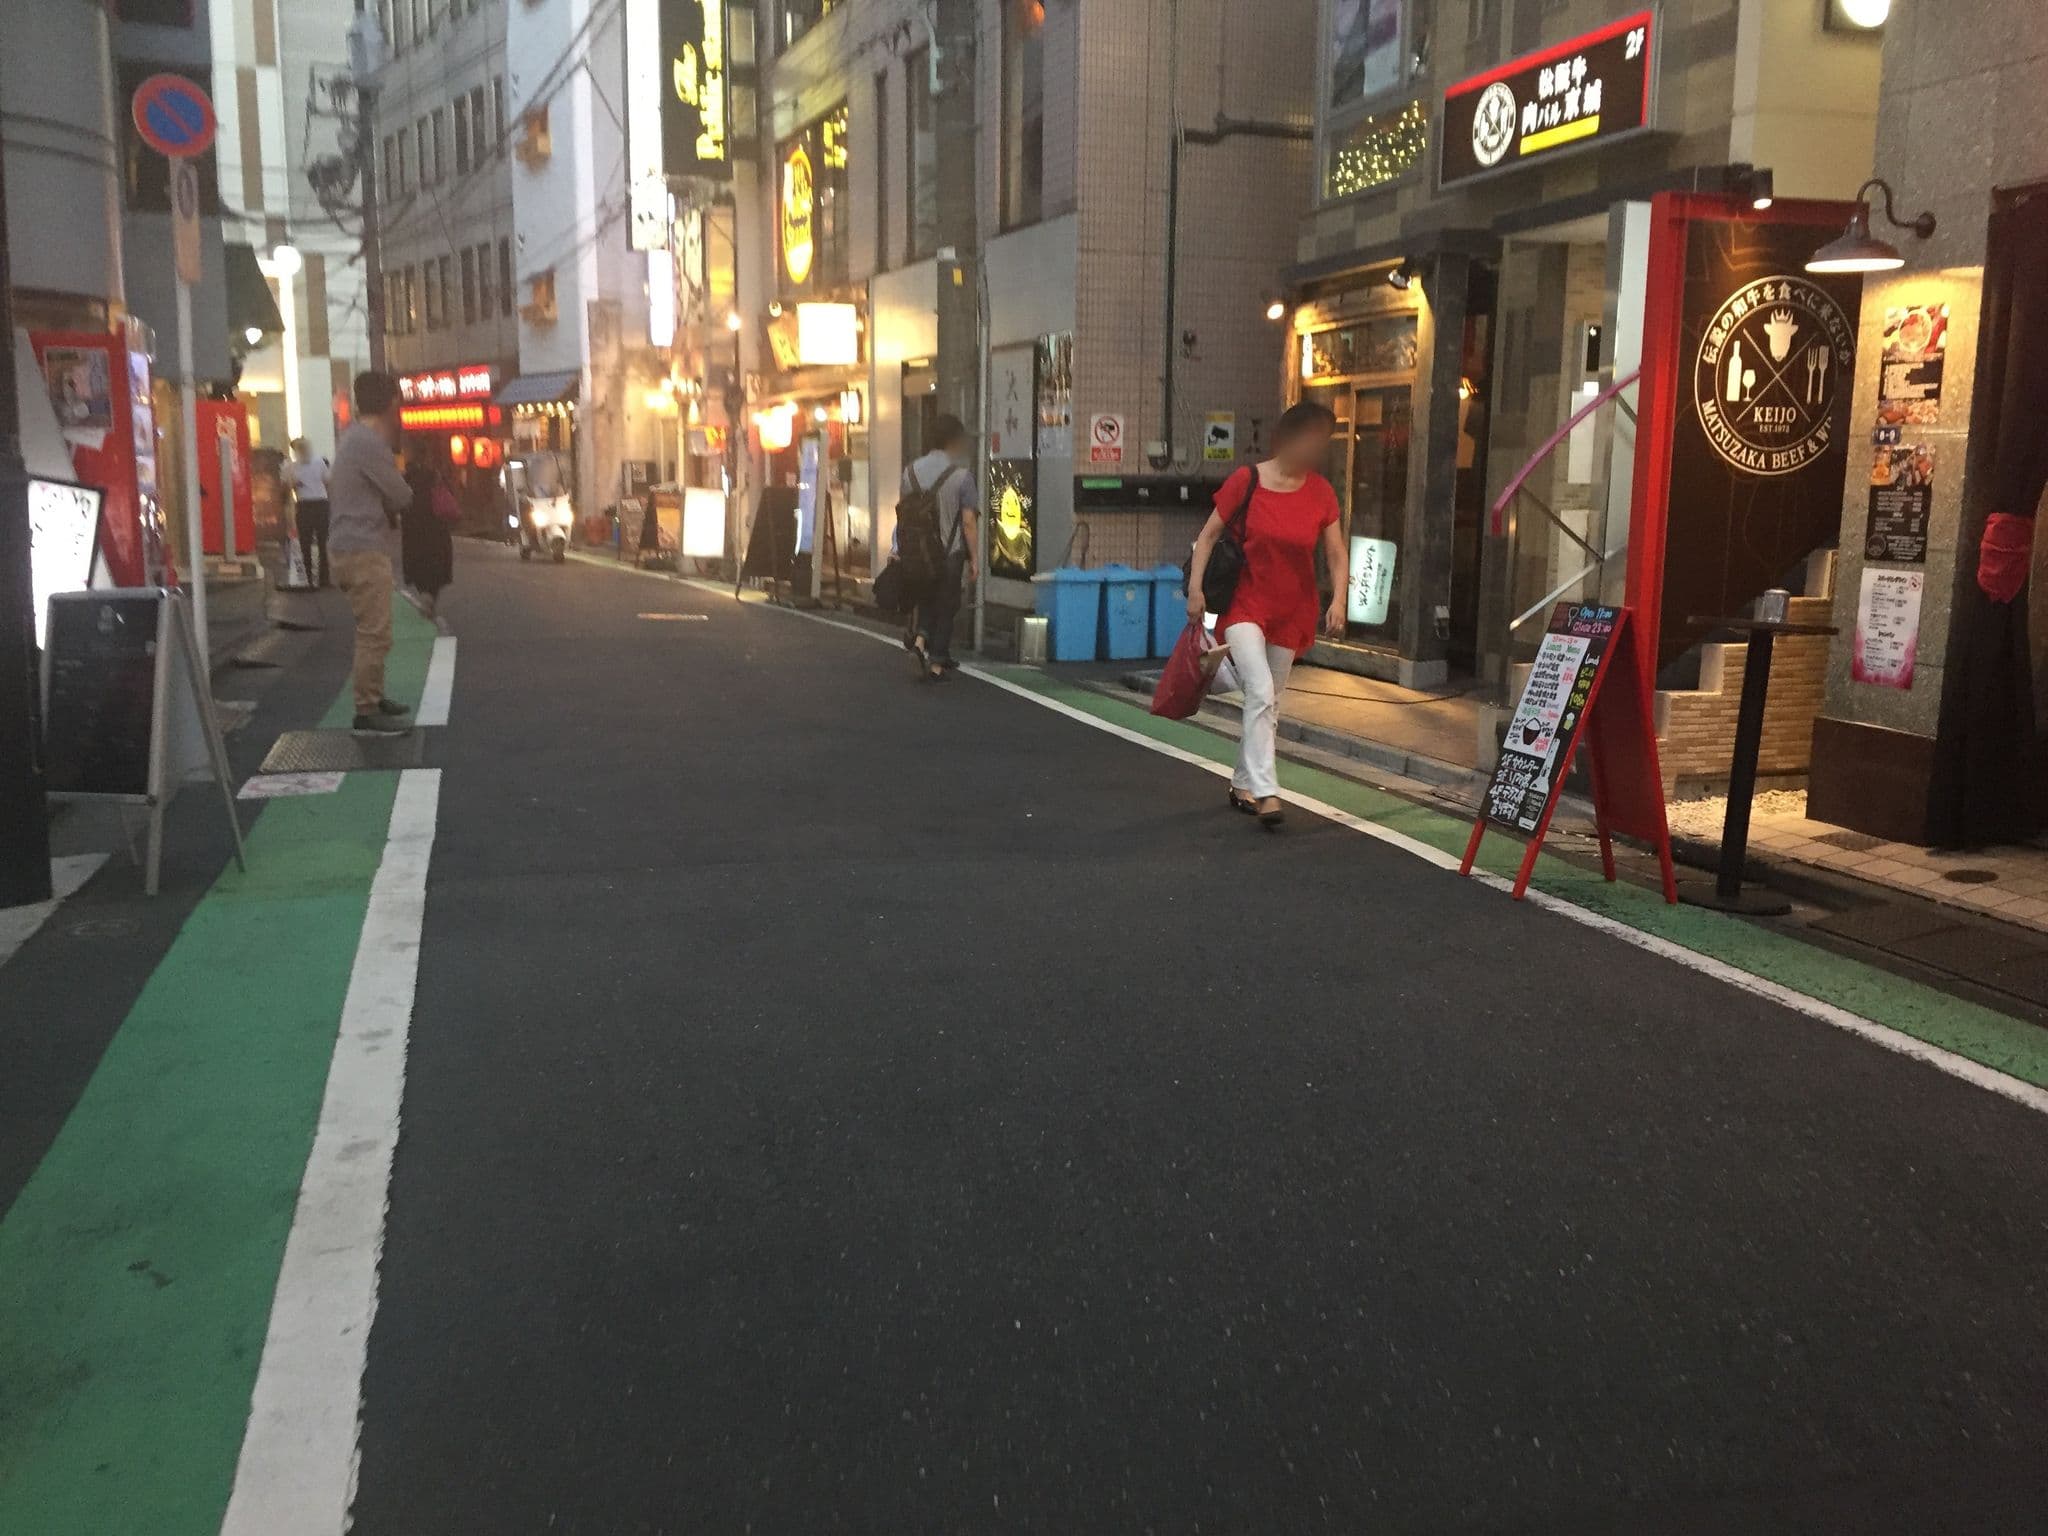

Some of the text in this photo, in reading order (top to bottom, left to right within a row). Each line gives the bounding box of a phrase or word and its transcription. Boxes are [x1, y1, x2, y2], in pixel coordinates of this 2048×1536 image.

[1702, 398, 1766, 470] MATSUZAKA
[1772, 444, 1805, 470] BEEF
[1806, 438, 1819, 453] &
[1753, 406, 1797, 424] KEIJO
